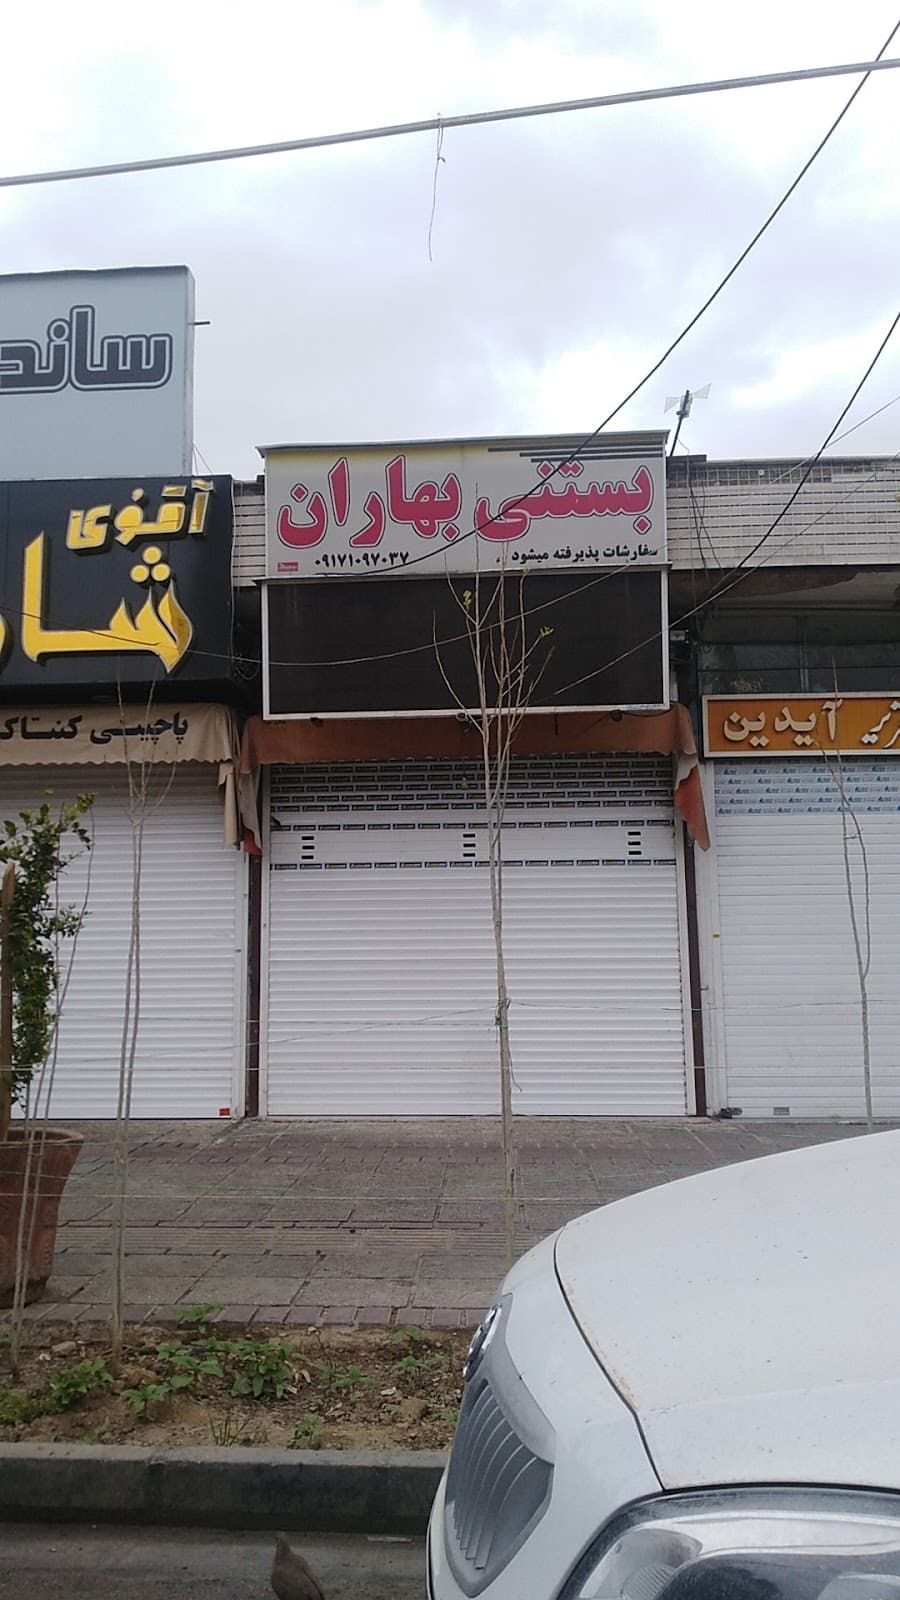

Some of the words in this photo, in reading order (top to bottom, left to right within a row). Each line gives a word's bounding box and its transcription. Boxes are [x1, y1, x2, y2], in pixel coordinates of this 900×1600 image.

[277, 455, 462, 549] بهاران
[474, 459, 654, 542] بستنی
[314, 551, 409, 568] ۰۹۱۷۱۰۹۷۰۳۷
[511, 548, 549, 565] میشود
[553, 545, 600, 562] پذیرفته
[602, 543, 658, 561] سفارشات
[723, 699, 844, 747] آیدین
